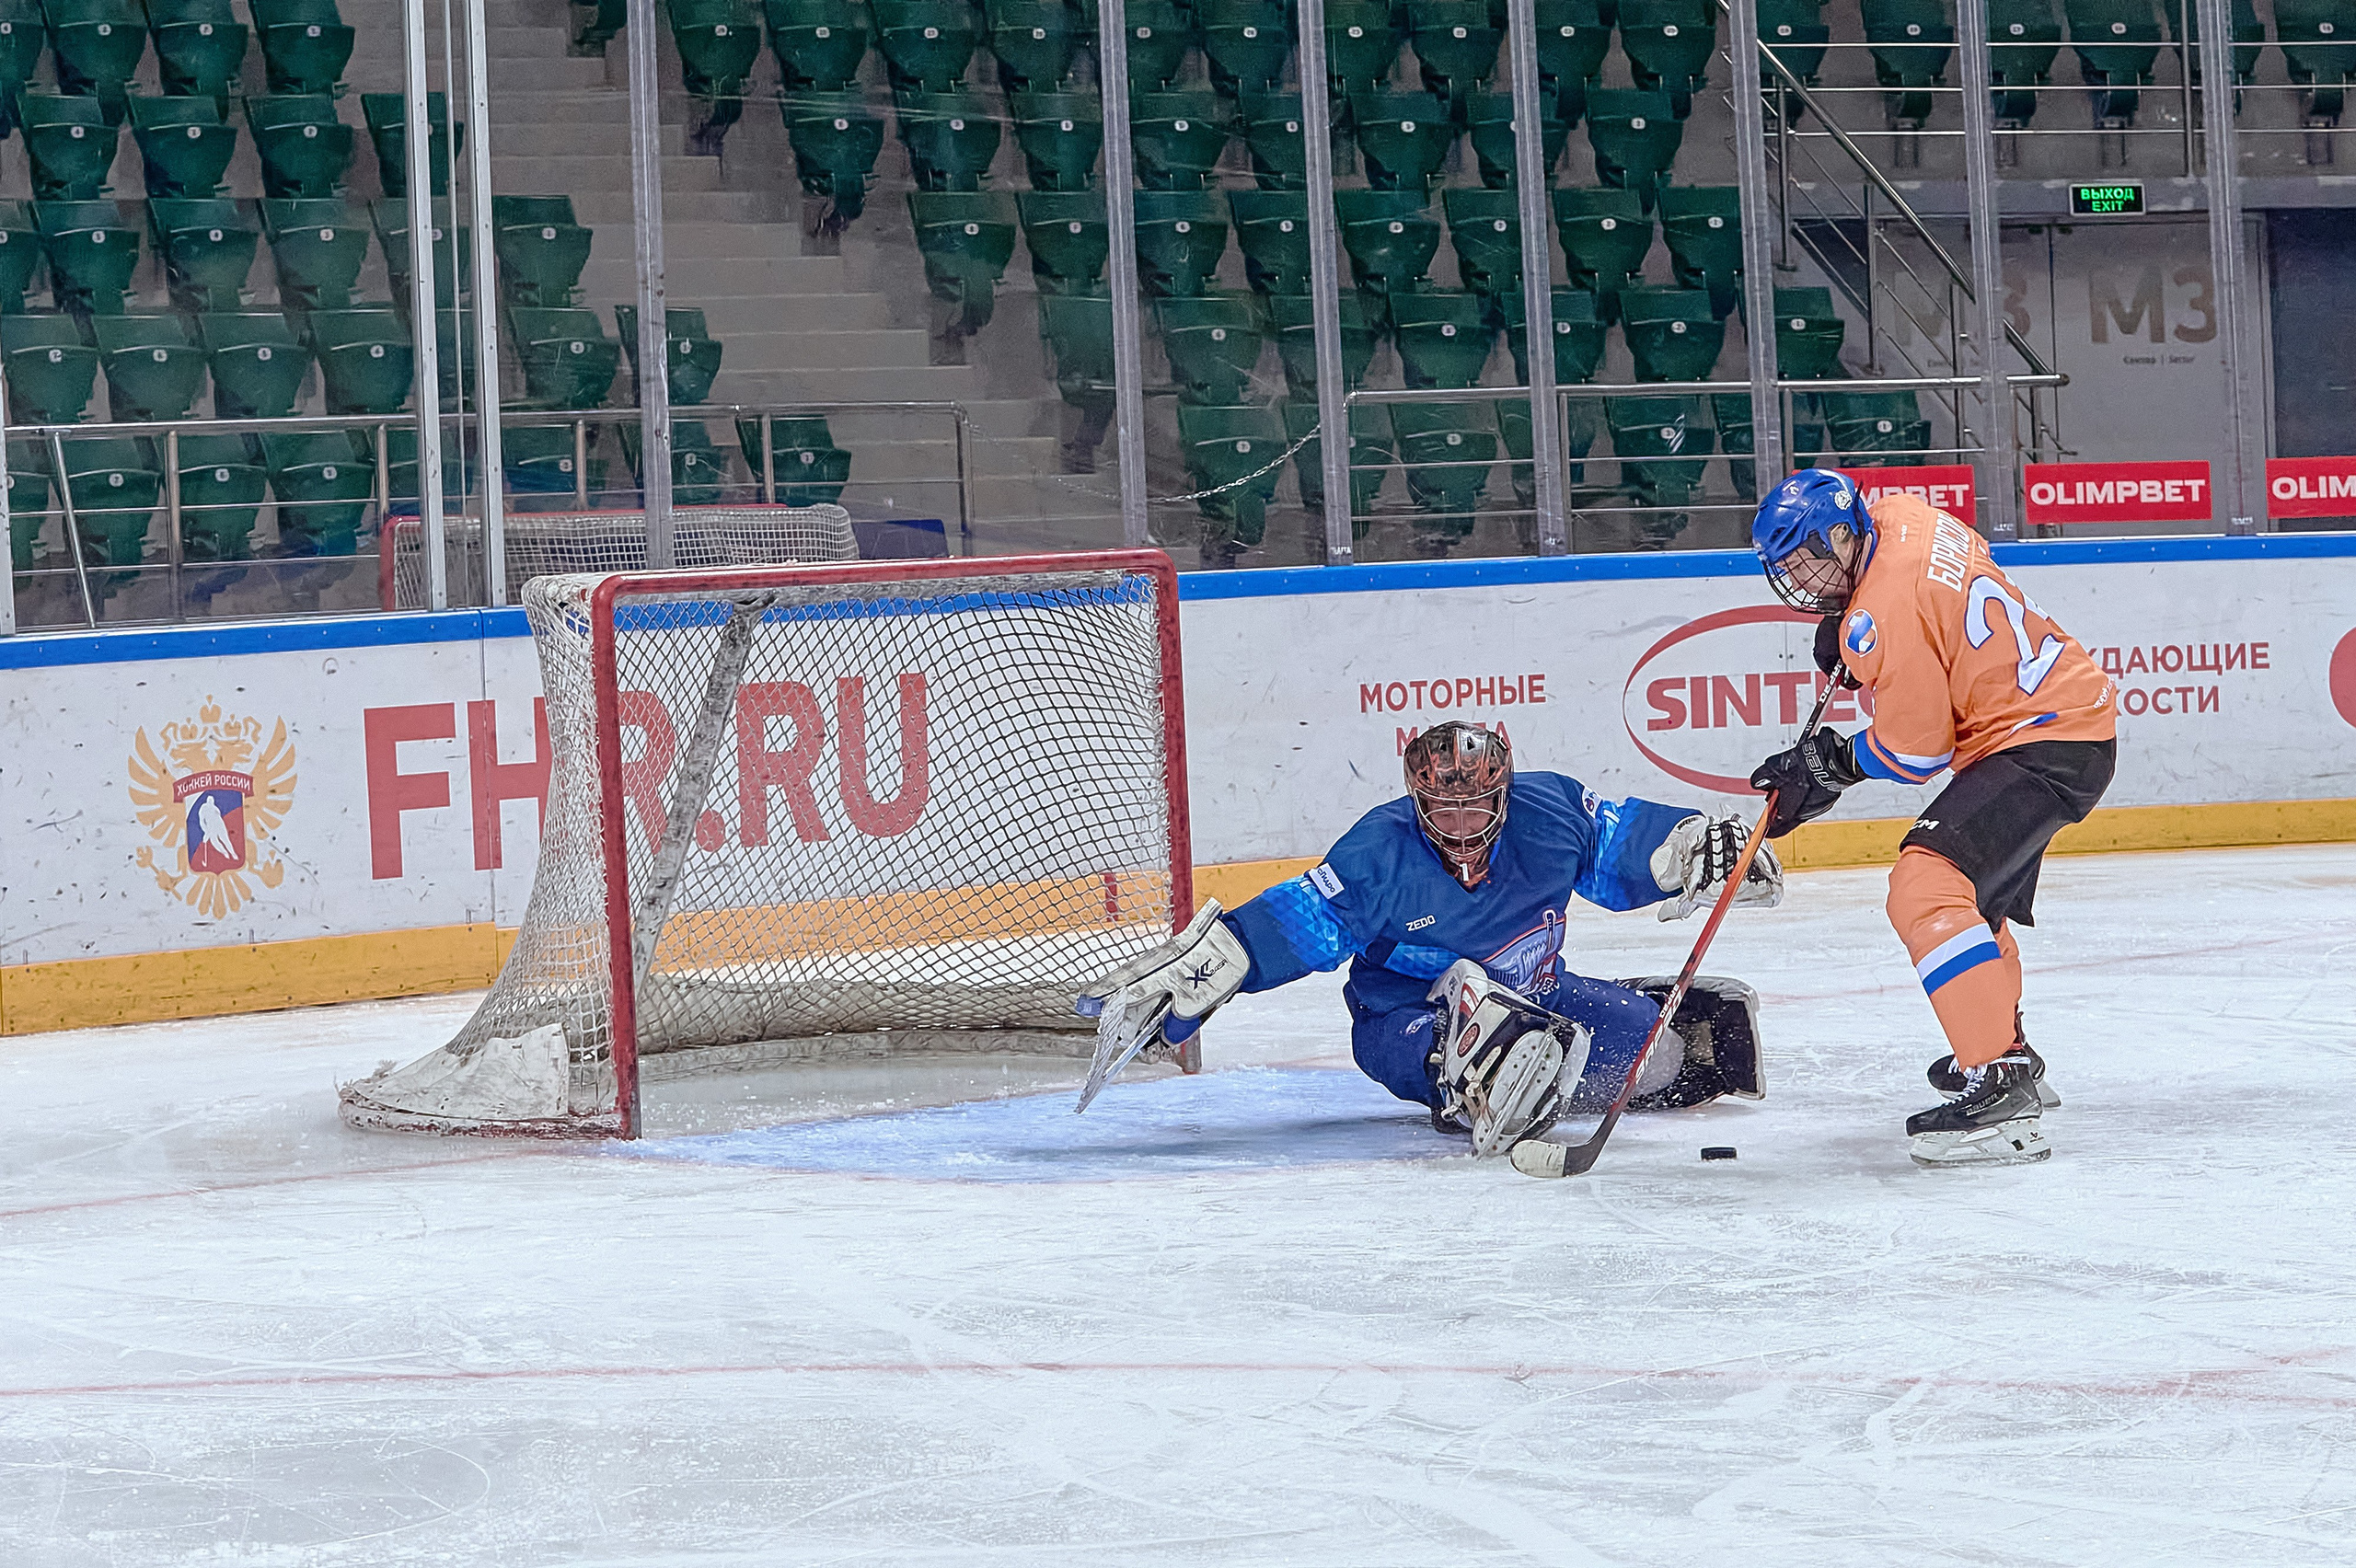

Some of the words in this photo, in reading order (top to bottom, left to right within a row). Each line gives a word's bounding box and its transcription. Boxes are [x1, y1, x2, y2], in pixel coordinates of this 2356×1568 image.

[2081, 188, 2134, 201] ВЫХОД
[2092, 201, 2124, 212] EXIT
[2030, 479, 2205, 505] OLIMPBET
[1964, 541, 2065, 698] 2
[2087, 641, 2270, 679] ДАЮЩИЕ
[1359, 674, 1546, 713] МОТОРНЫЕ
[2116, 686, 2219, 716] ОСТИ
[178, 774, 212, 796] ХОККЕЙ
[214, 775, 250, 791] РОССИИ
